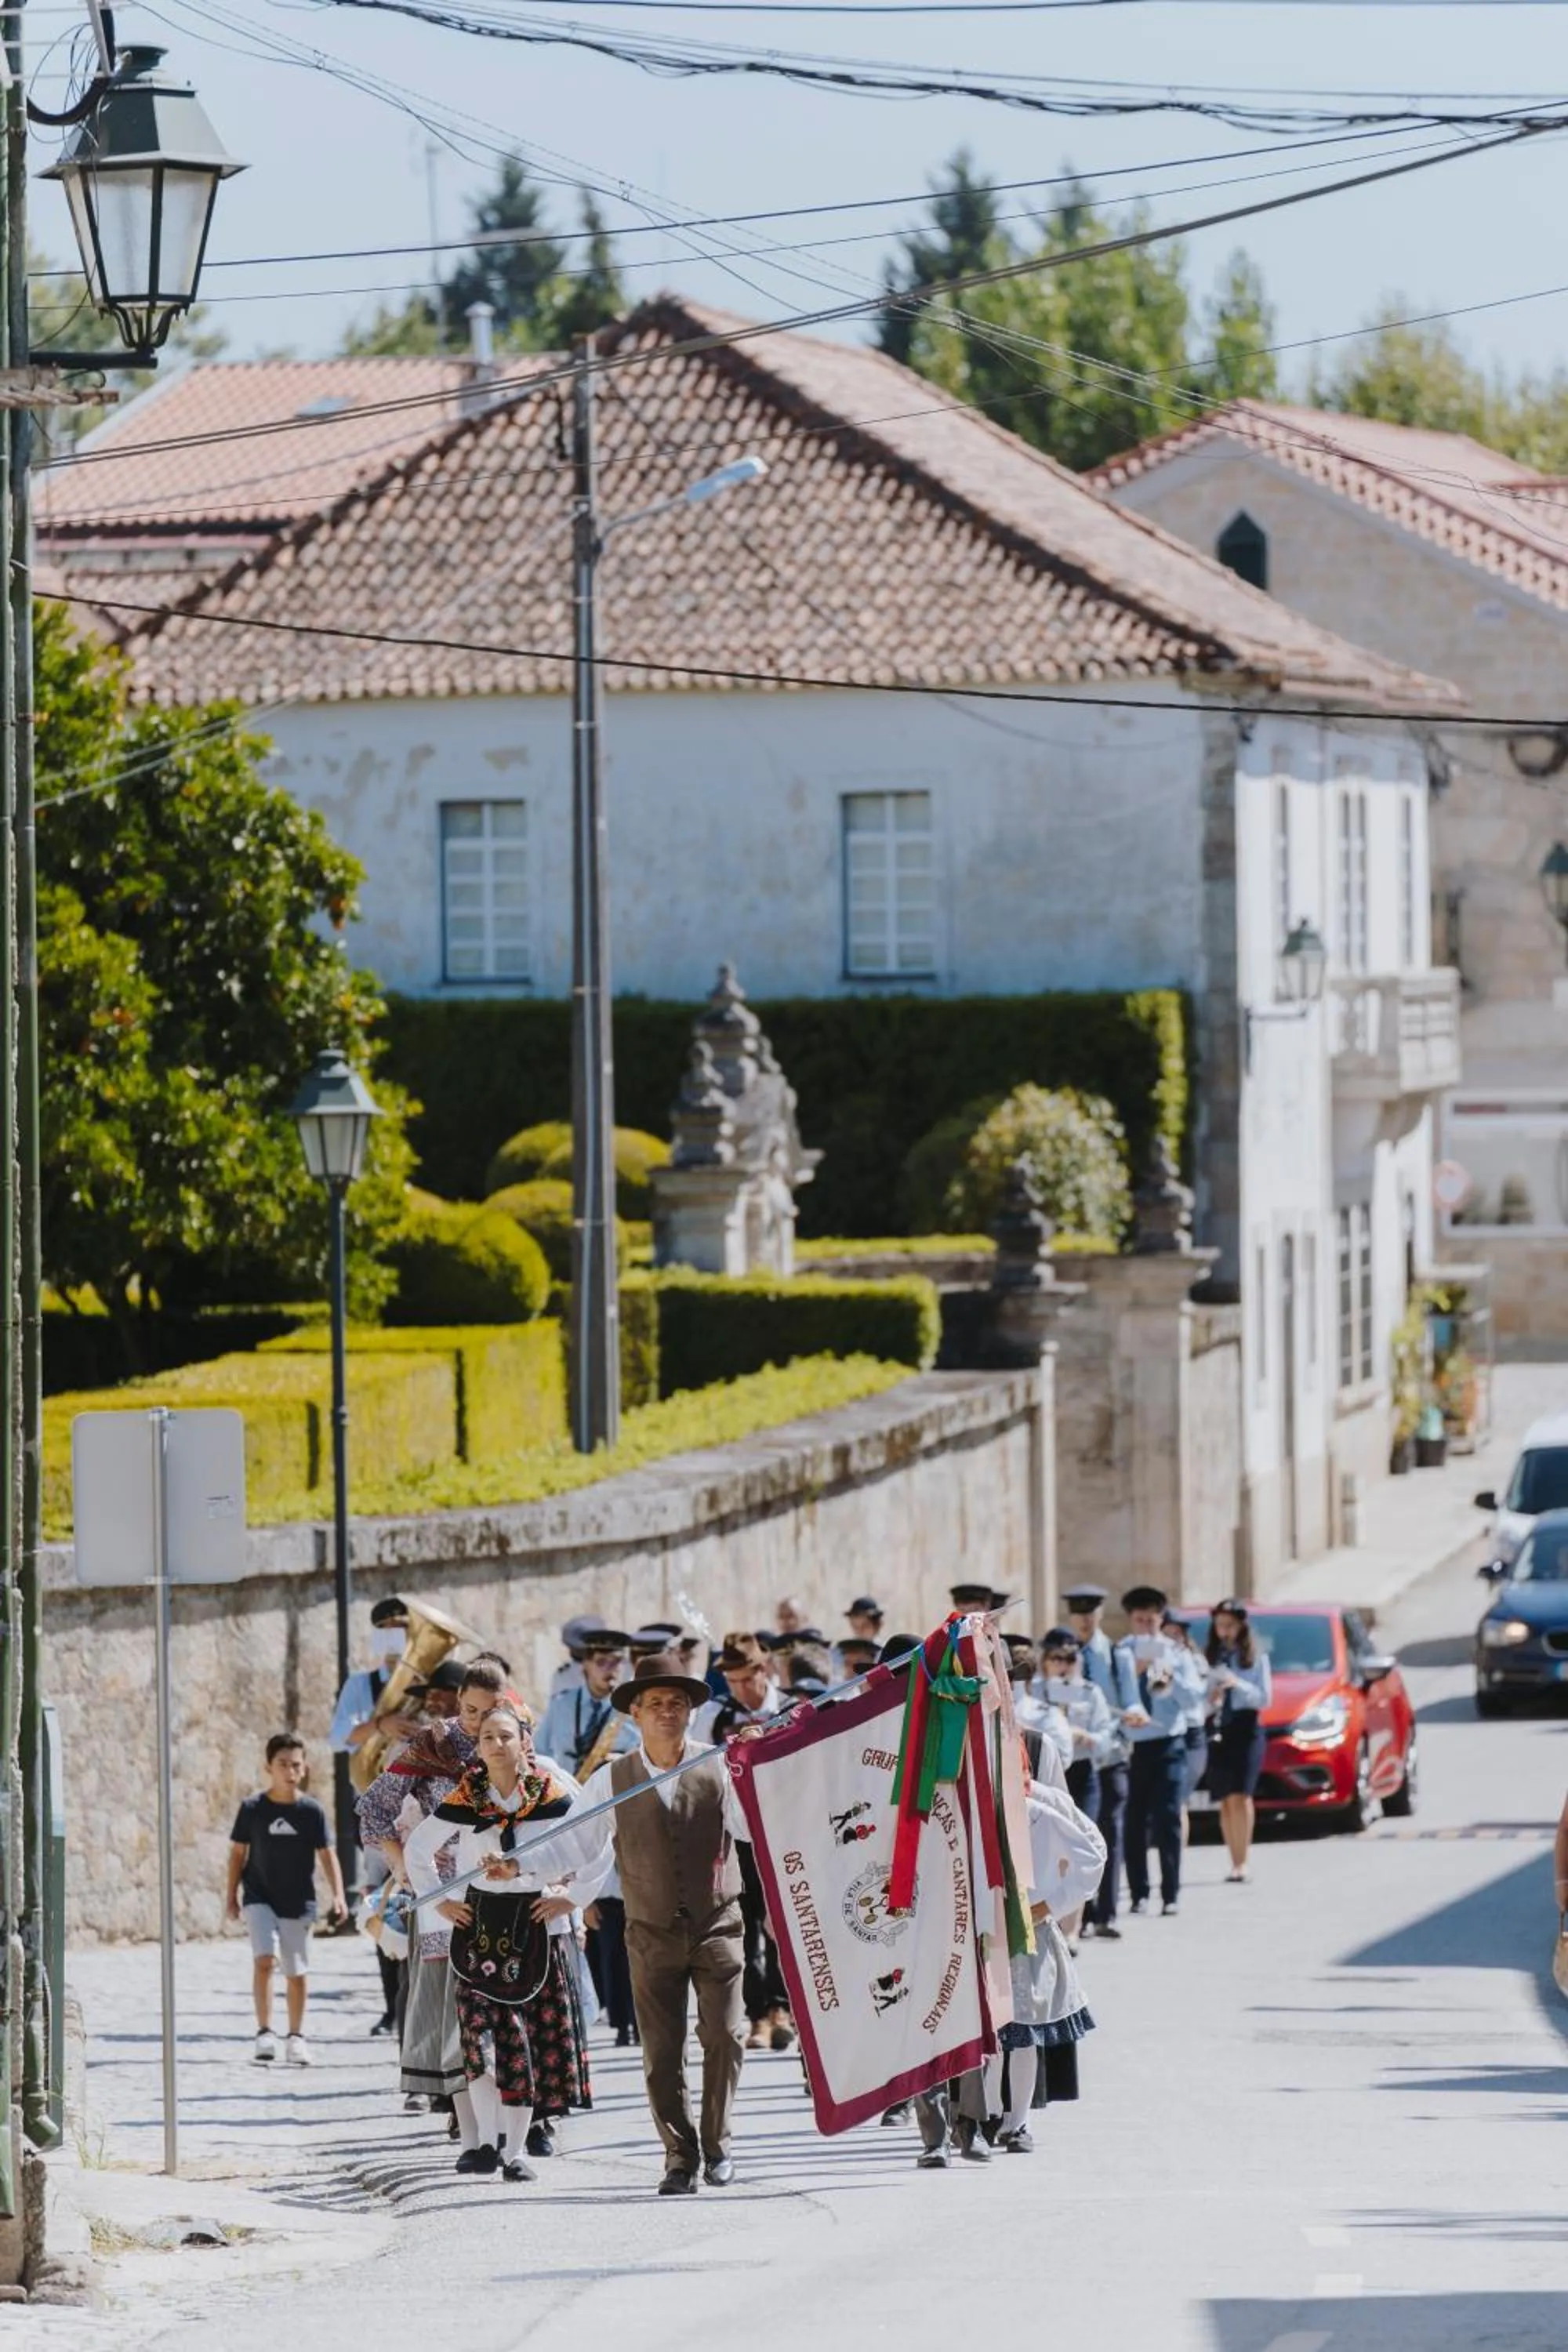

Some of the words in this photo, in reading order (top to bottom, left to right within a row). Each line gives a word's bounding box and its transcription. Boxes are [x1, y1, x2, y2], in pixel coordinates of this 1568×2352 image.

[862, 1748, 898, 1771] GRUP
[783, 1850, 804, 1875] OS
[948, 1836, 959, 1851] E
[953, 1857, 969, 1945] CANTARES
[789, 1881, 840, 2012] SANTARENSES
[922, 1952, 963, 2035] REGIONAIS
